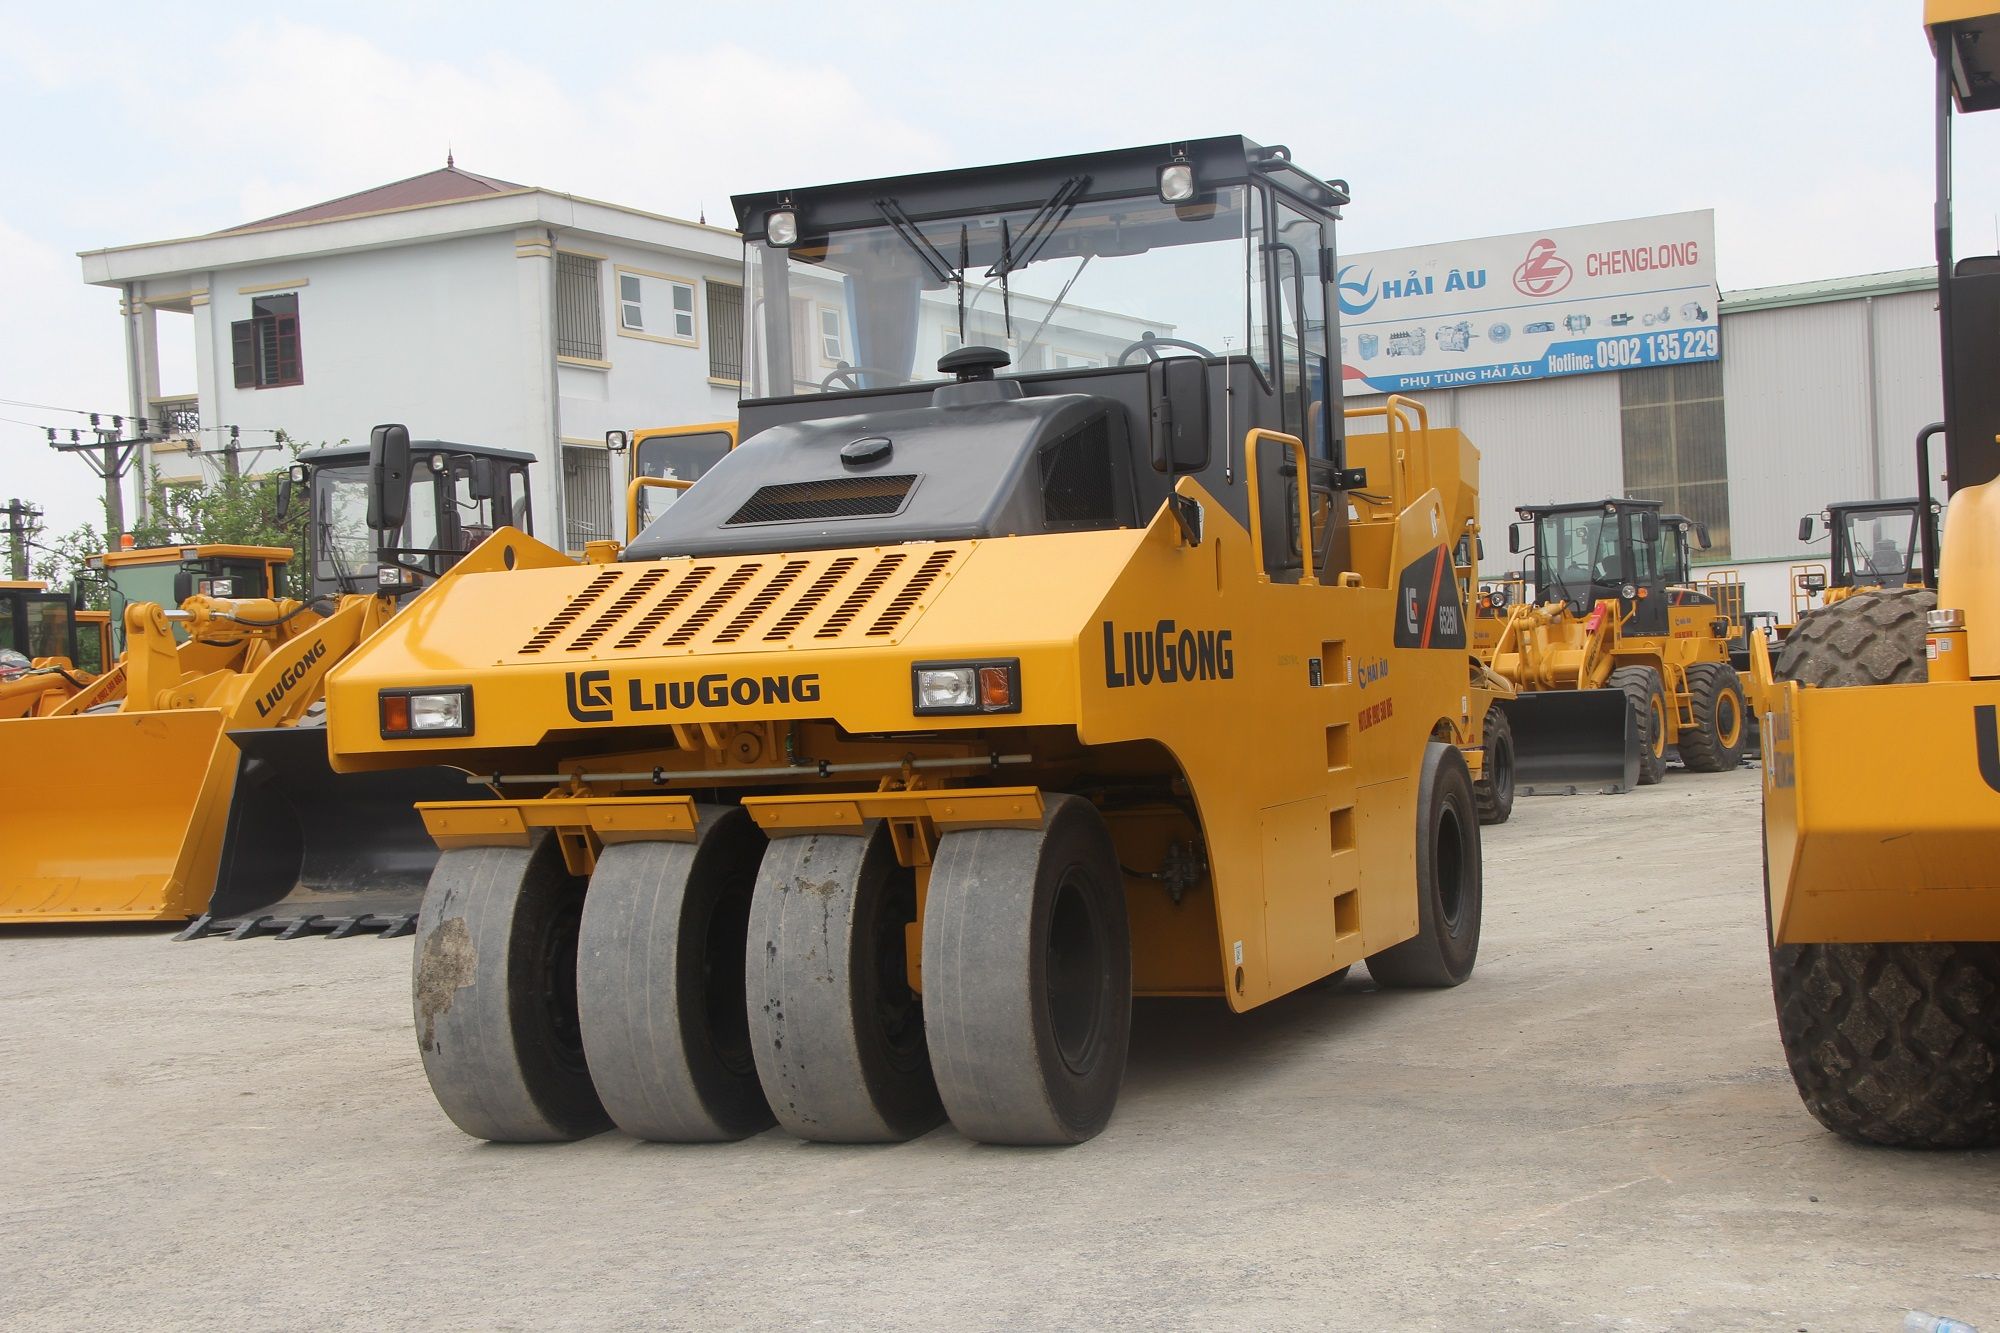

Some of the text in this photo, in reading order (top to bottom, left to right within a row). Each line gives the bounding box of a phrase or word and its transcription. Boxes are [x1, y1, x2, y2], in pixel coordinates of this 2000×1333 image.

[1586, 241, 1698, 277] CHENGLONG
[1382, 268, 1487, 300] HẢI ÂU
[1548, 328, 1719, 374] Hotline: 0902 135 229
[1399, 363, 1532, 388] PHỤ TÙNG HẢI ÂU
